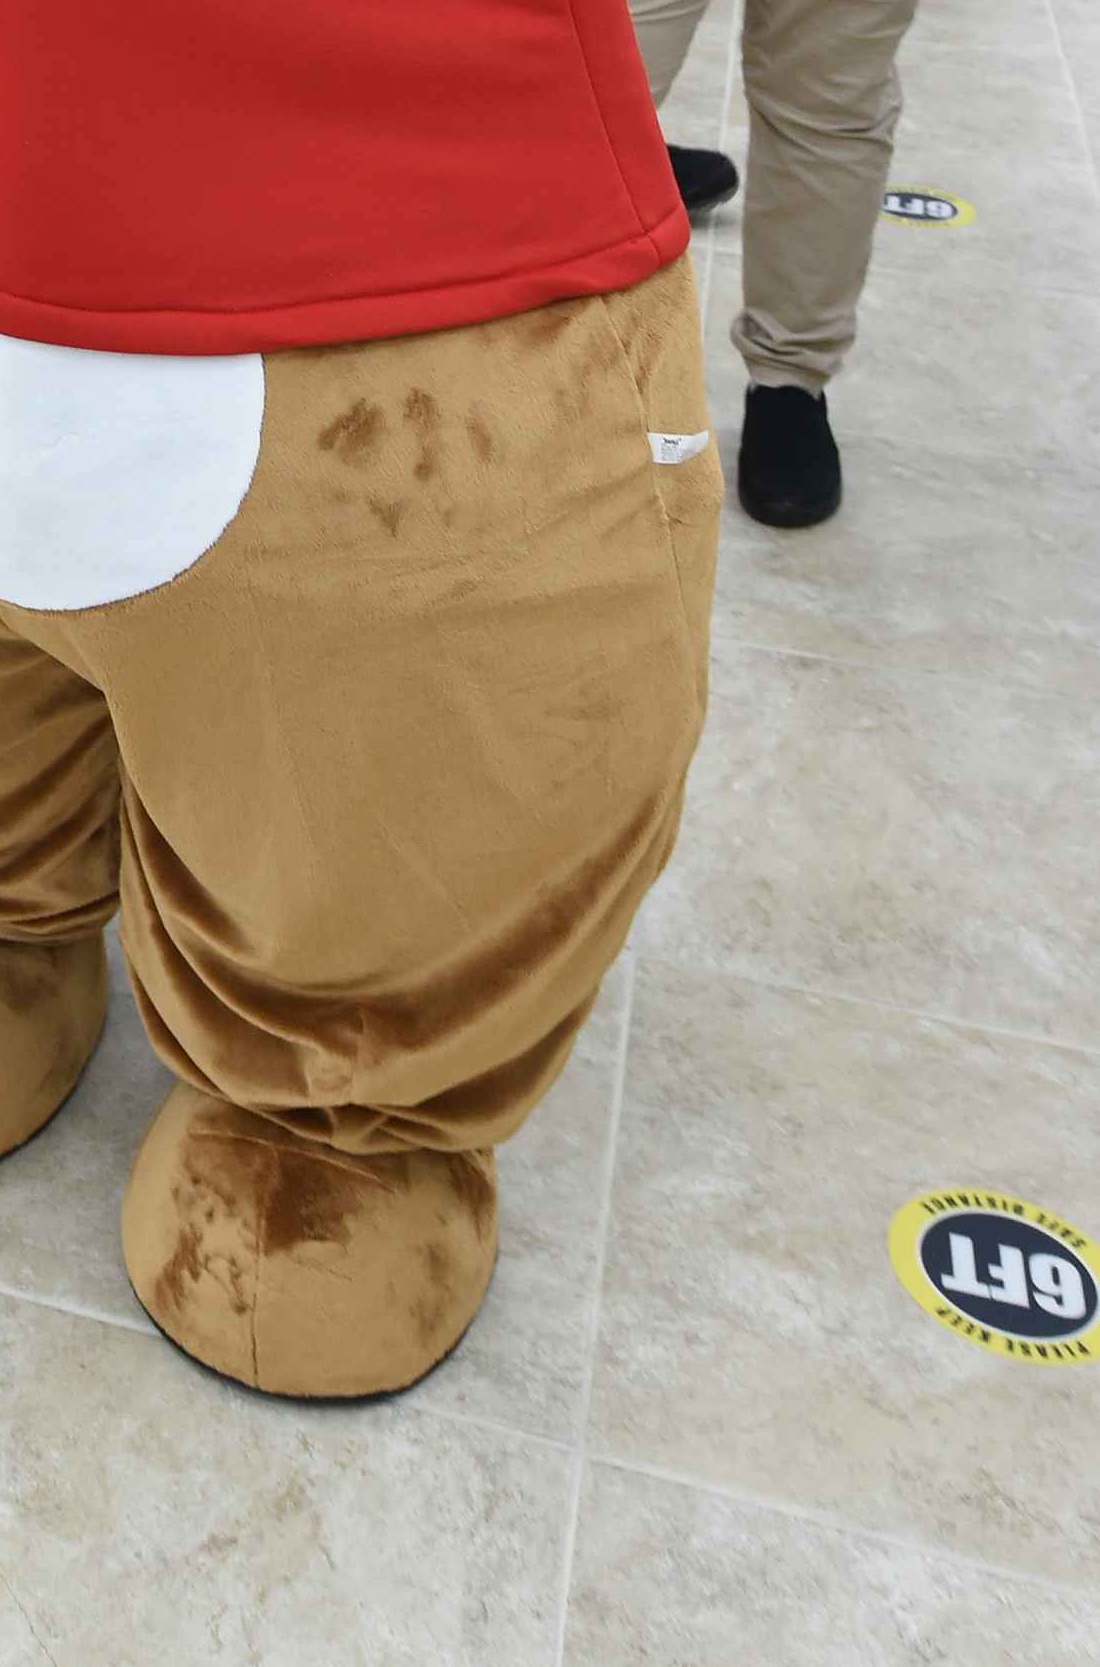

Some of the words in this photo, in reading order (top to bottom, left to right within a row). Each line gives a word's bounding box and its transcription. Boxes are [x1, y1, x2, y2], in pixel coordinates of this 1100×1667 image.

[882, 195, 952, 218] 6FT
[920, 1193, 1025, 1216] DISTANCE
[1035, 1212, 1087, 1249] SAFE
[940, 1232, 1087, 1320] 6FT
[936, 1306, 991, 1343] KEEP
[1005, 1338, 1090, 1360] PLEASE
